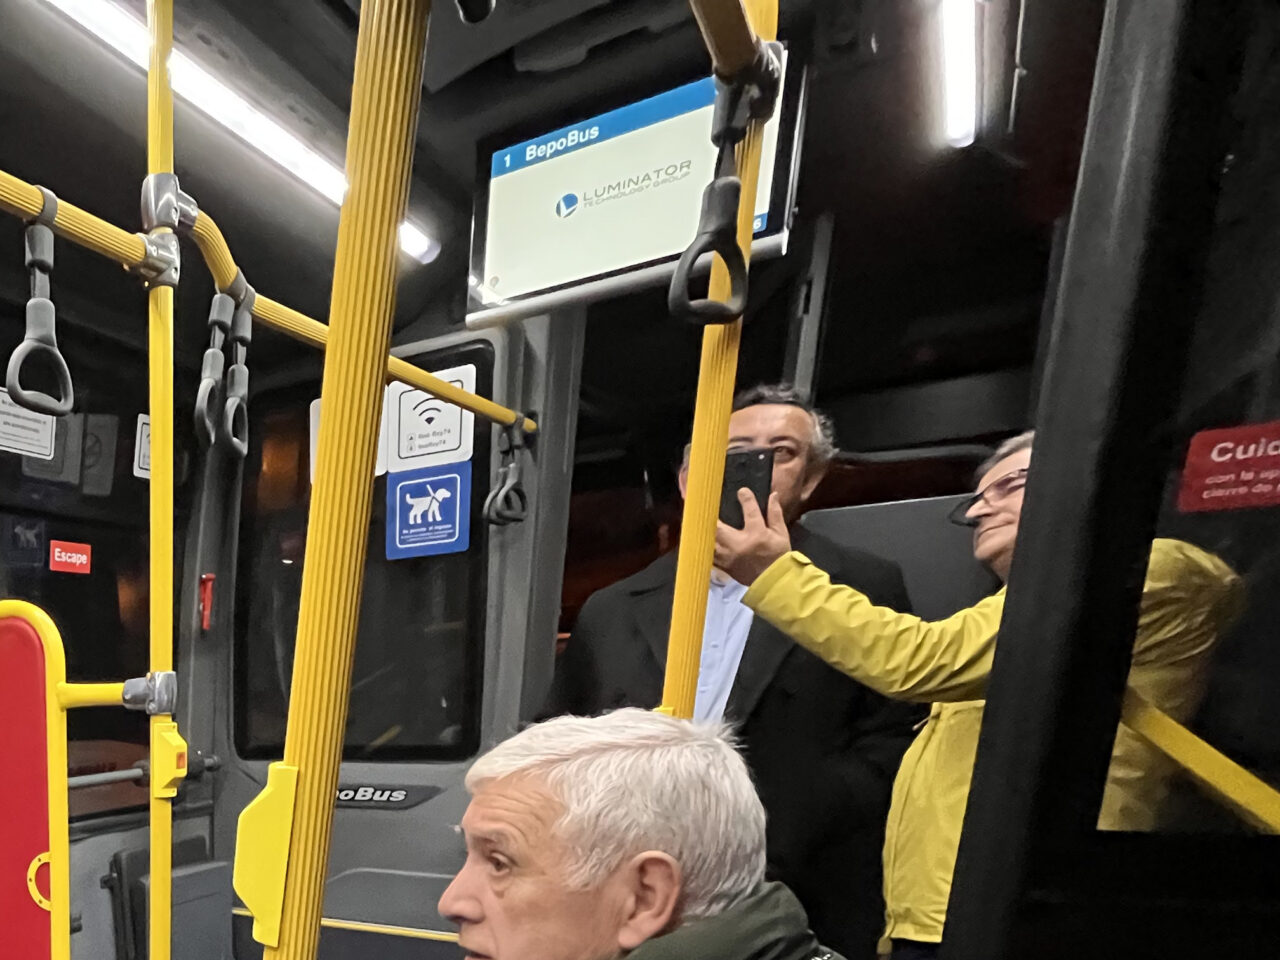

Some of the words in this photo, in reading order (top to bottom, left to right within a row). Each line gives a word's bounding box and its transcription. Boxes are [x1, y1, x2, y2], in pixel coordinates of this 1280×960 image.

[503, 153, 511, 168] 1
[525, 126, 600, 162] BepoBus
[583, 160, 692, 201] LUMINATOR
[54, 547, 88, 567] Escape
[336, 786, 407, 802] oBus
